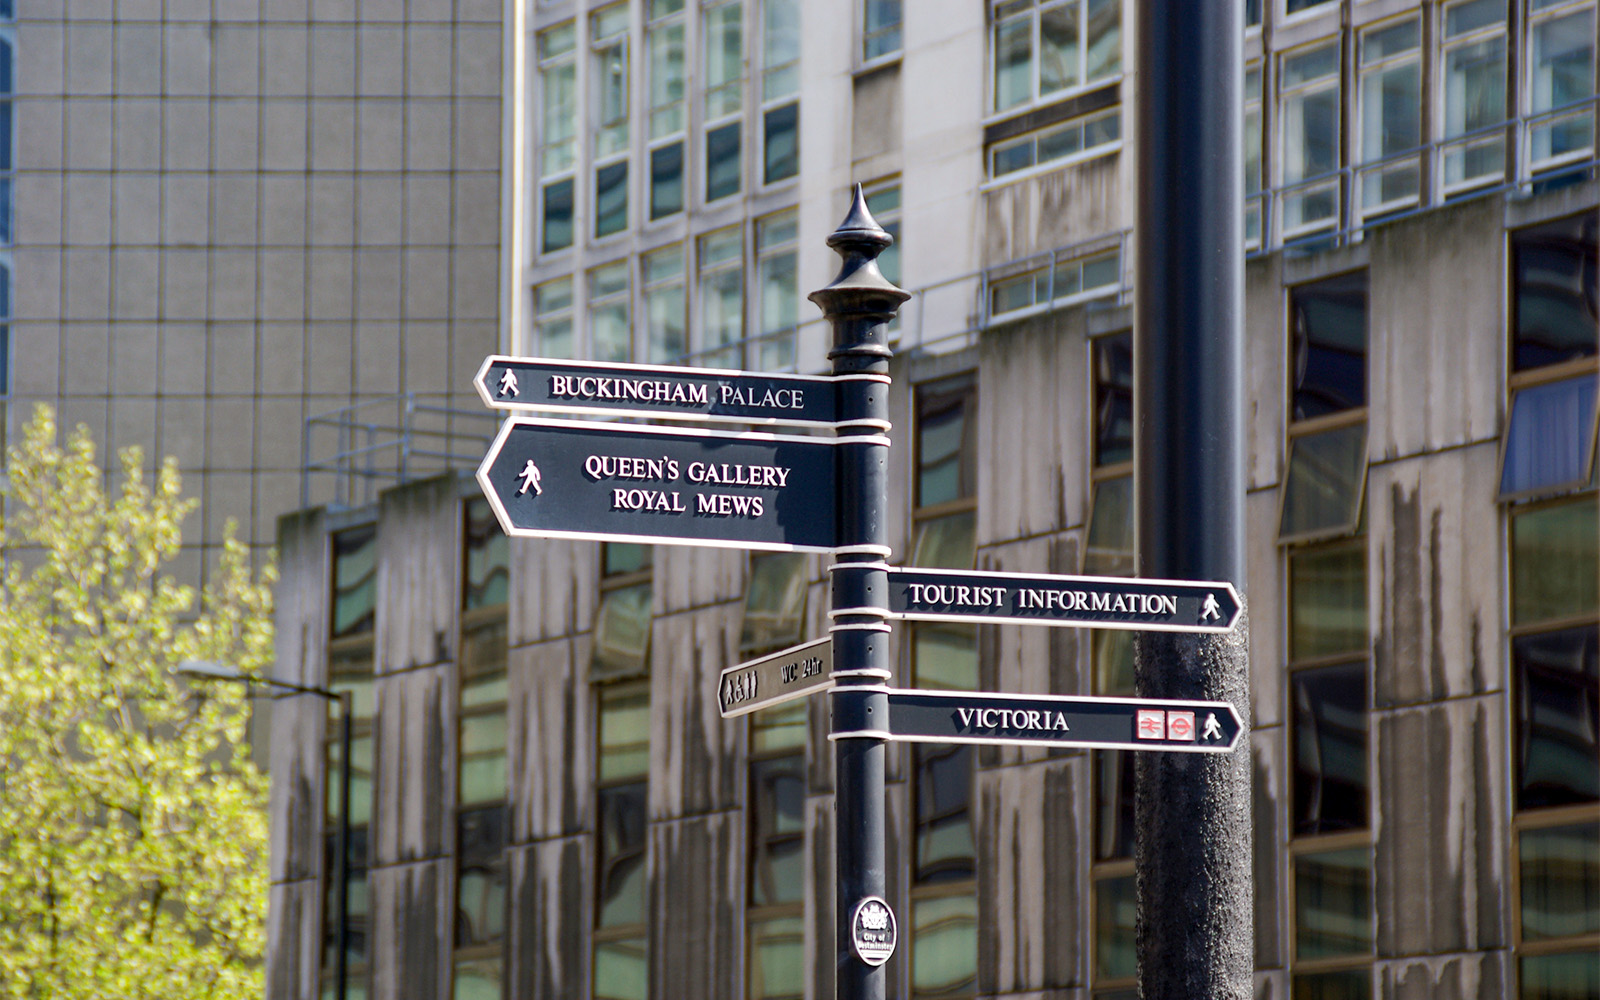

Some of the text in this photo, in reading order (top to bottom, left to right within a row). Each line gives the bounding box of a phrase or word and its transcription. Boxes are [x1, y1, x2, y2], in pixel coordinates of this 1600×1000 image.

[552, 375, 805, 409] BUCKINGHAM PALACE
[585, 455, 791, 487] QUEEN'S GALLERY
[613, 489, 764, 517] ROYAL MEWS
[909, 584, 1178, 615] TOURIST INFORMATION
[780, 657, 823, 683] WC 24hr
[957, 708, 1070, 732] VICTORIA
[863, 933, 885, 942] City of
